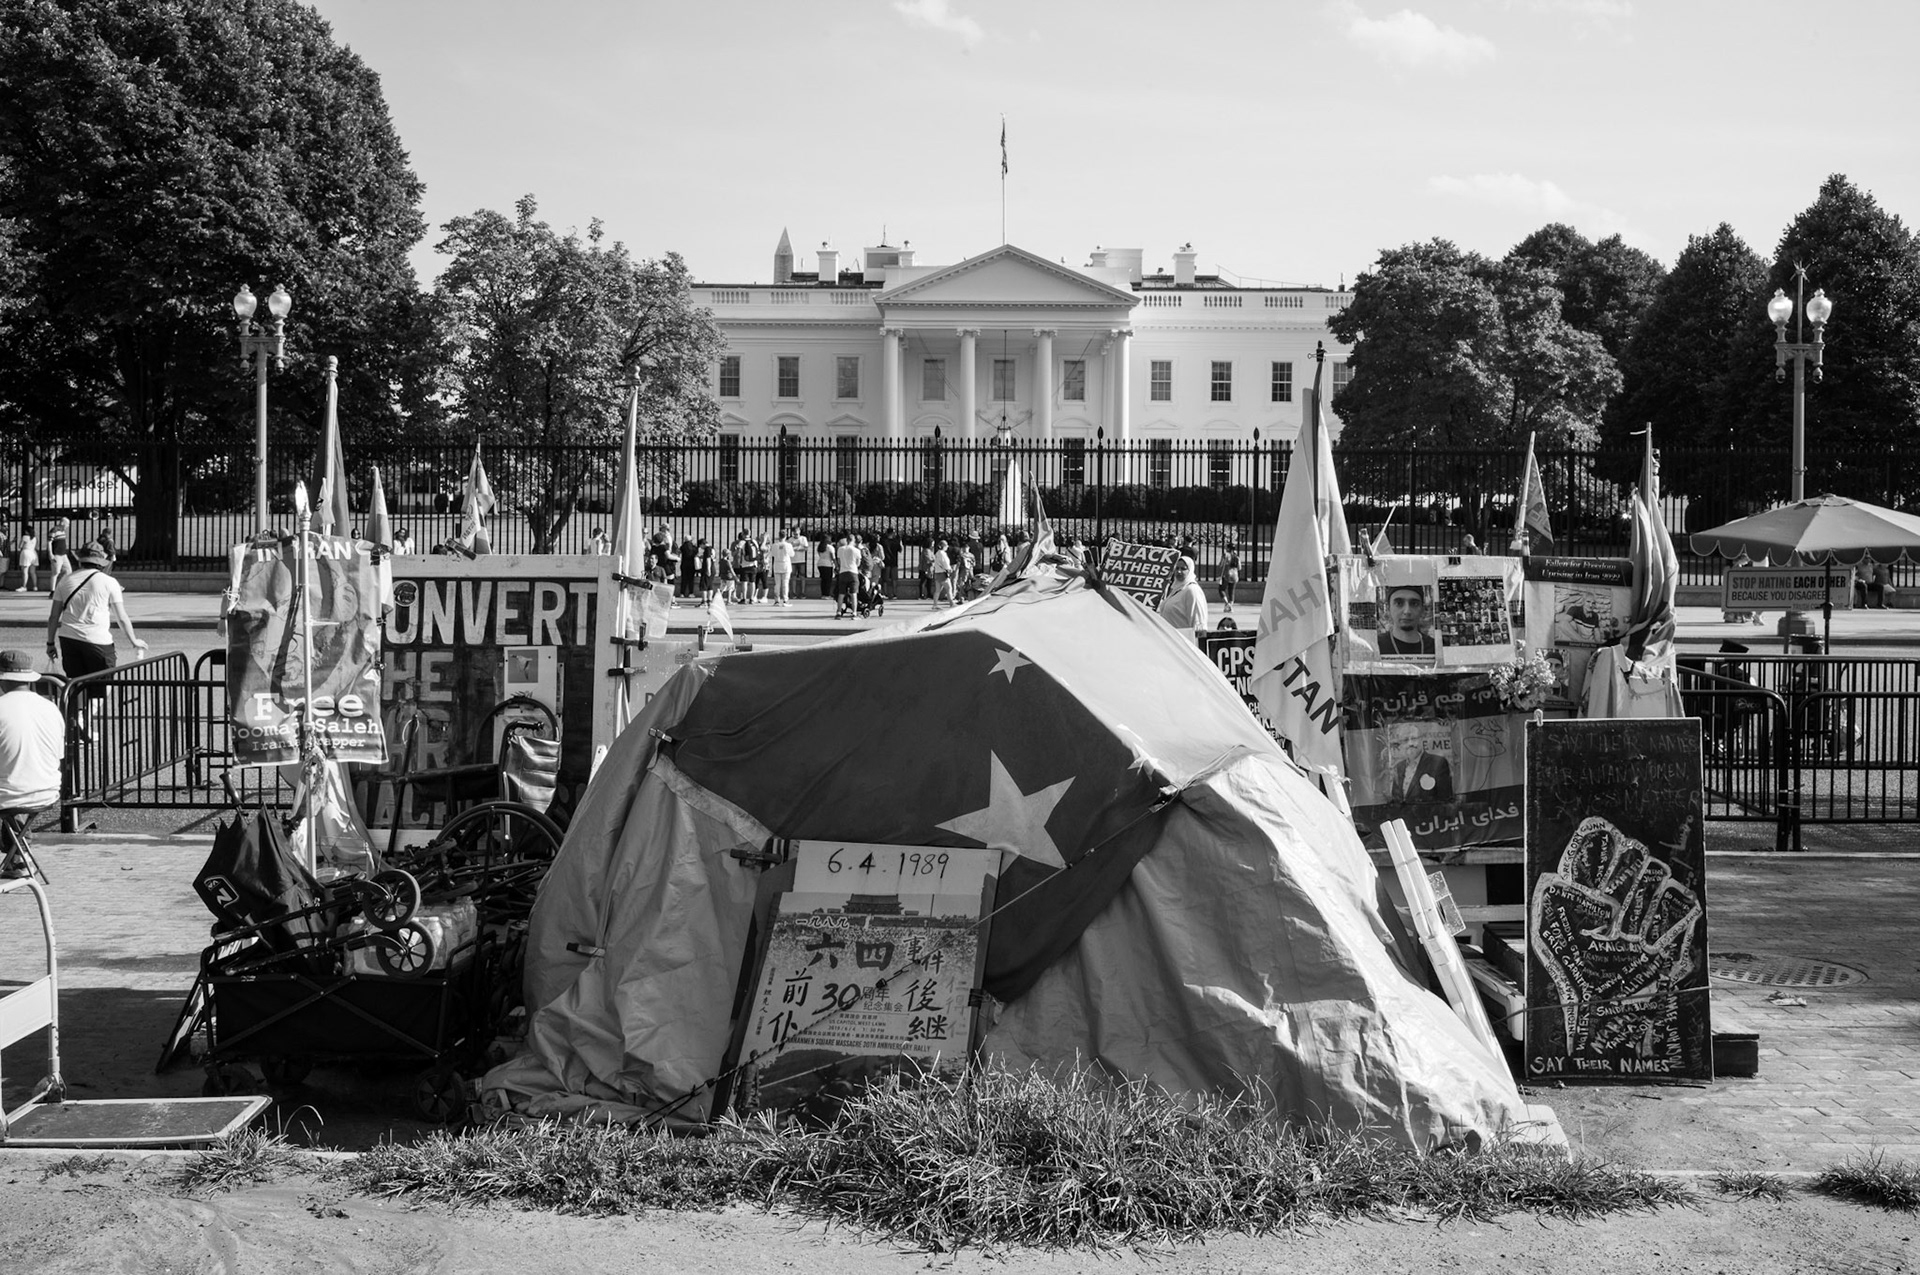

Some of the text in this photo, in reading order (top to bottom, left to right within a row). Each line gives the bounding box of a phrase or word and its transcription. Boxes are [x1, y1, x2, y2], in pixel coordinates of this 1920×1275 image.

[1108, 542, 1174, 564] BLACK
[1104, 558, 1170, 576] FATHERS
[1101, 572, 1164, 588] MATTER
[1732, 575, 1846, 589] STOP HATING EACH OHER
[1731, 590, 1826, 601] BECAUSE YOU DISAGREE
[384, 580, 598, 646] ONVERT
[384, 651, 455, 702] HE
[253, 692, 364, 721] Free
[1273, 656, 1340, 736] TAN
[1384, 690, 1428, 712] قرآن
[319, 736, 366, 750] rapper
[1415, 802, 1520, 836] فدای ایران
[1542, 930, 1563, 955] ERIC
[1530, 1056, 1671, 1074] SAY THEIR NAMES
